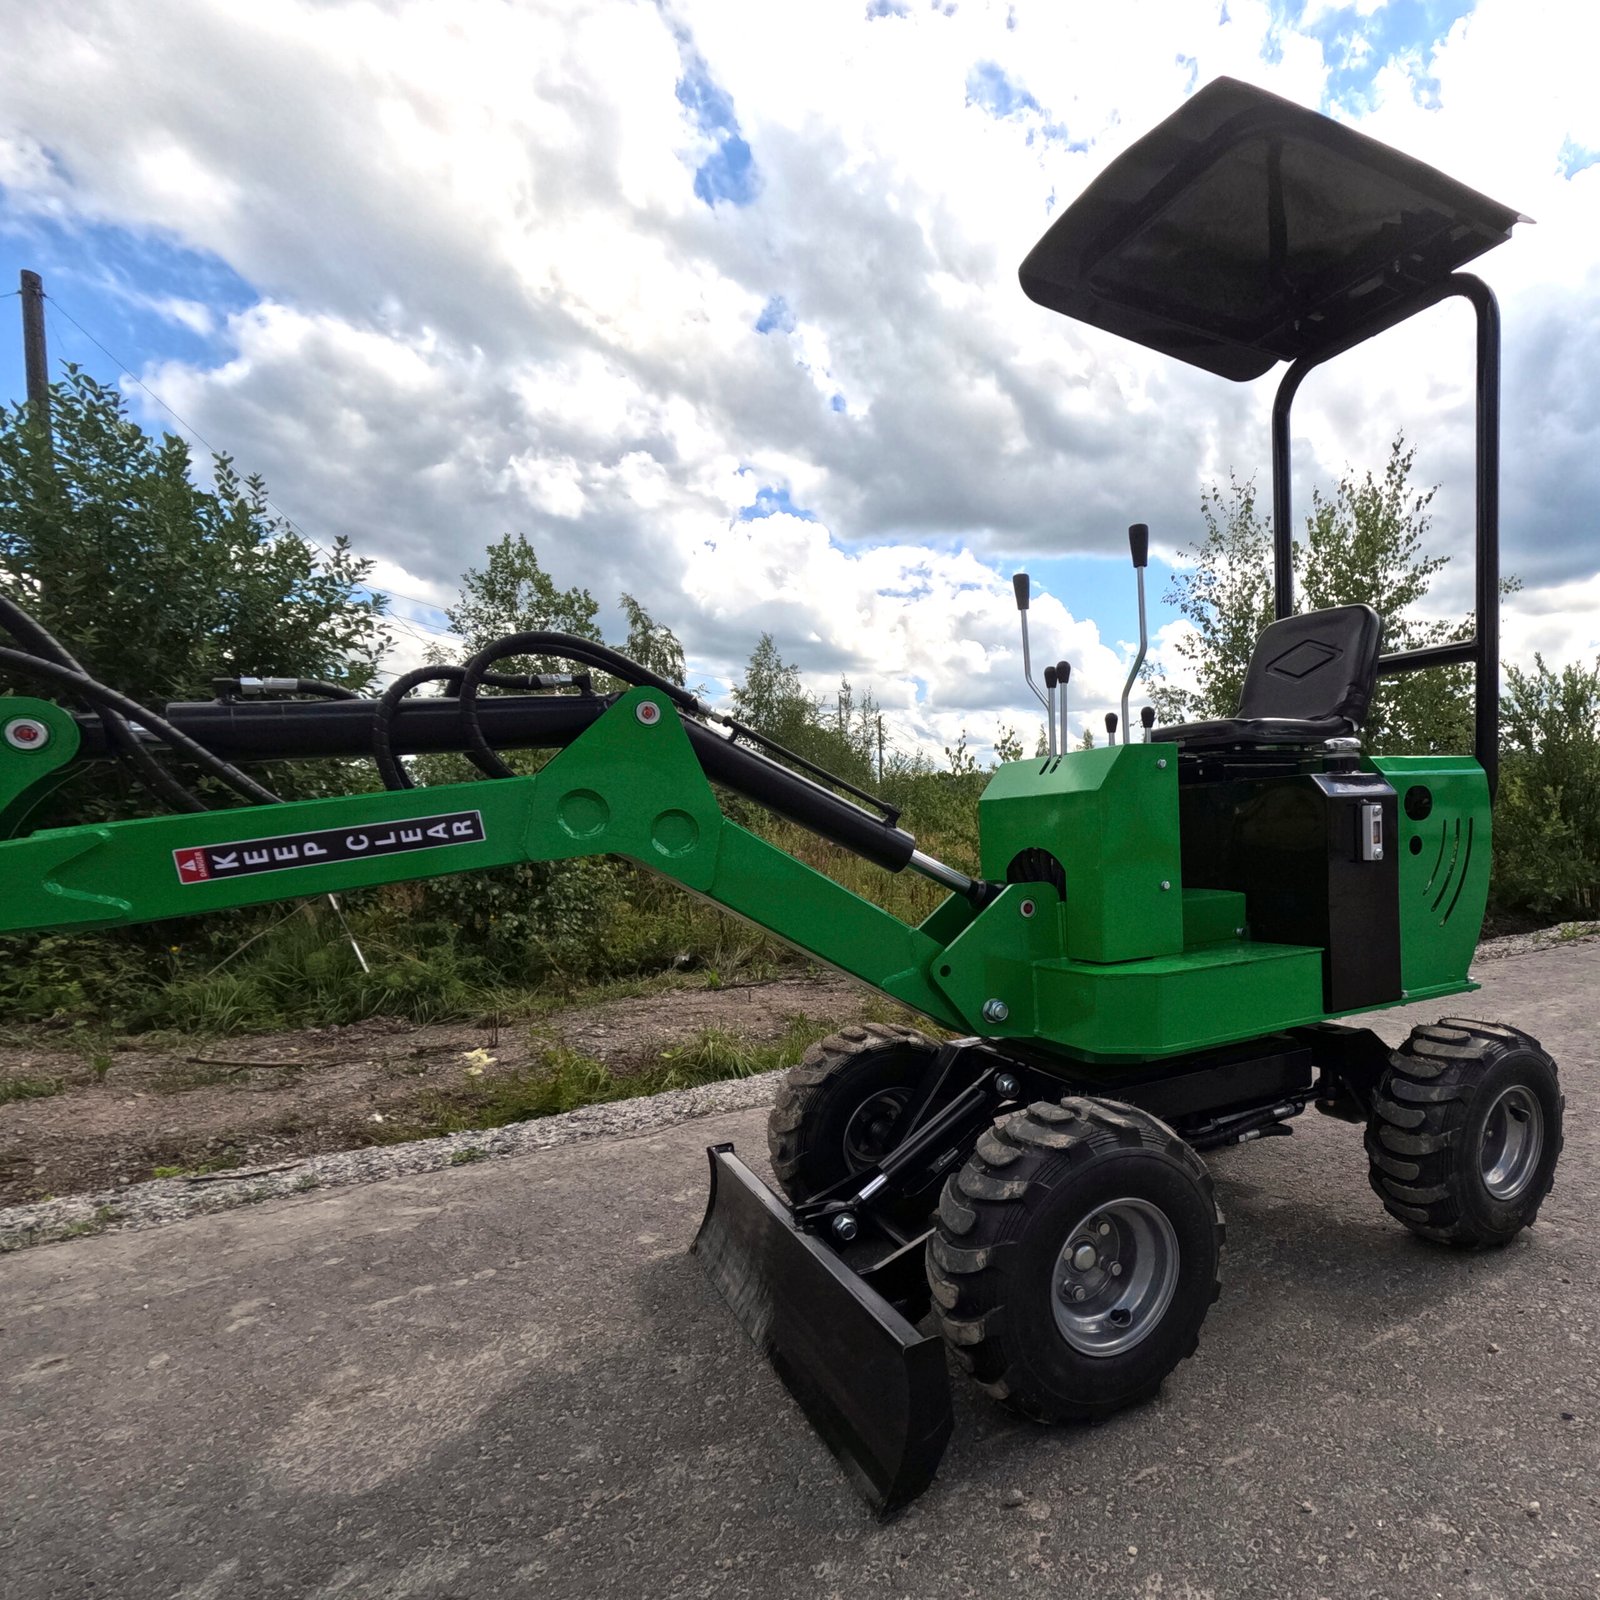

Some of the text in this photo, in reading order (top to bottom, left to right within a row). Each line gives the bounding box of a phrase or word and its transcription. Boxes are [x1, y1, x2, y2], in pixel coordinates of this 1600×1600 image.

[213, 819, 474, 870] KEEP CLEAR
[194, 851, 207, 877] DANGER
